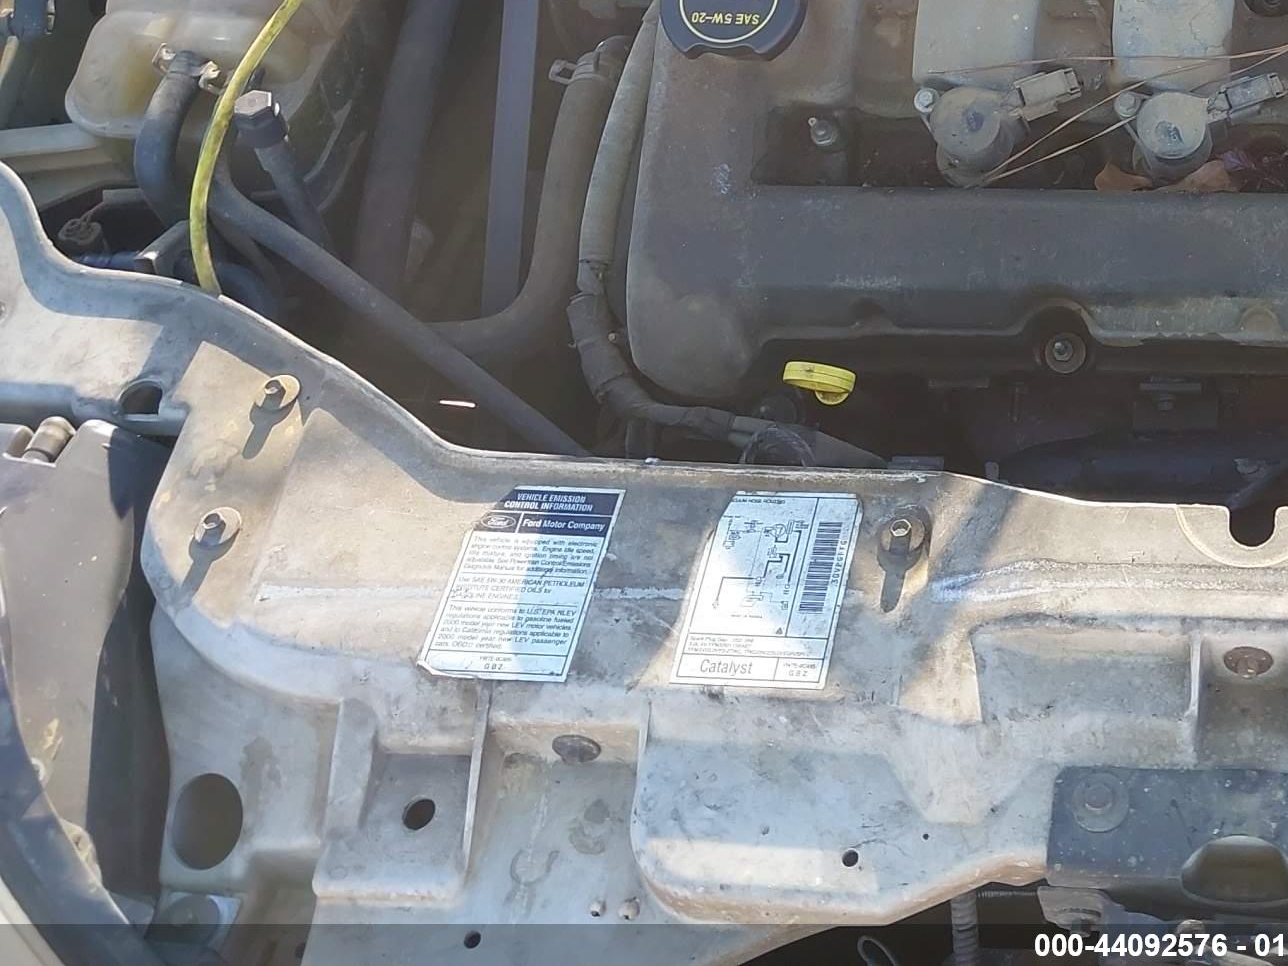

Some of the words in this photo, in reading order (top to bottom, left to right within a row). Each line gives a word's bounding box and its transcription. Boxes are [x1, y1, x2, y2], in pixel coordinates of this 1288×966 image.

[691, 12, 733, 24] 5W-20
[735, 13, 760, 25] SAE
[517, 493, 548, 501] VEHICLE
[549, 494, 586, 503] EMISSION
[504, 500, 539, 510] CONTROL
[540, 502, 593, 512] INFORMATION
[522, 518, 542, 527] Ford
[543, 520, 566, 529] Motor
[568, 521, 605, 532] Company
[700, 658, 753, 677] Catalyst
